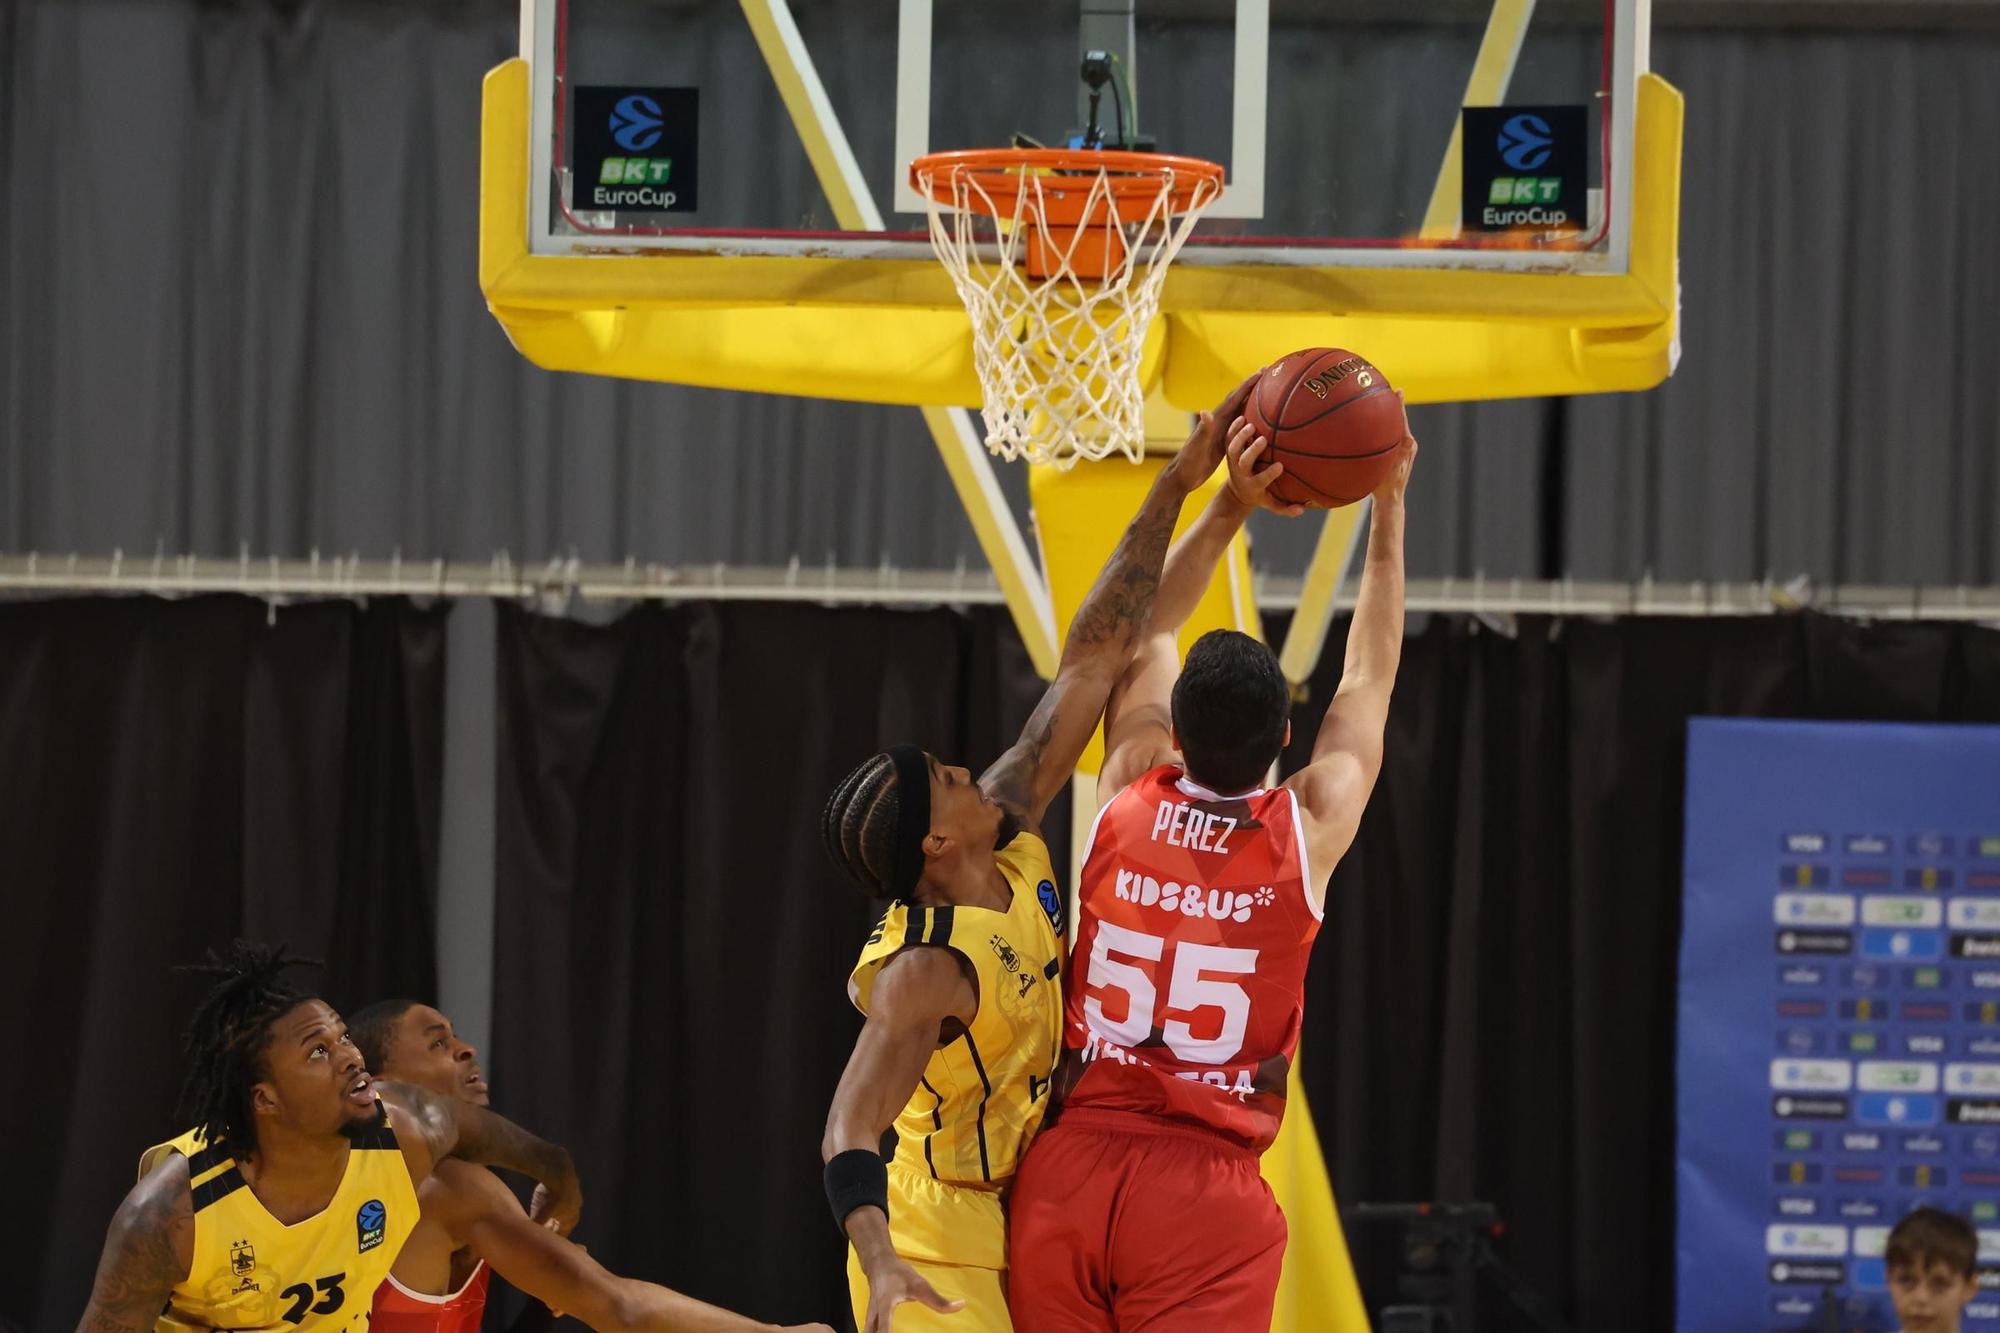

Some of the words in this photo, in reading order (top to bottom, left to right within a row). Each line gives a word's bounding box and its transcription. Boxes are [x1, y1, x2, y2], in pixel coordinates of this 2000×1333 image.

[600, 159, 671, 183] BKT
[593, 187, 677, 208] EuroCup
[1490, 179, 1560, 203] BKT
[1483, 207, 1567, 227] EuroCup
[1151, 799, 1238, 855] PÉREZ
[1083, 919, 1260, 1065] 55
[279, 1271, 347, 1326] 23
